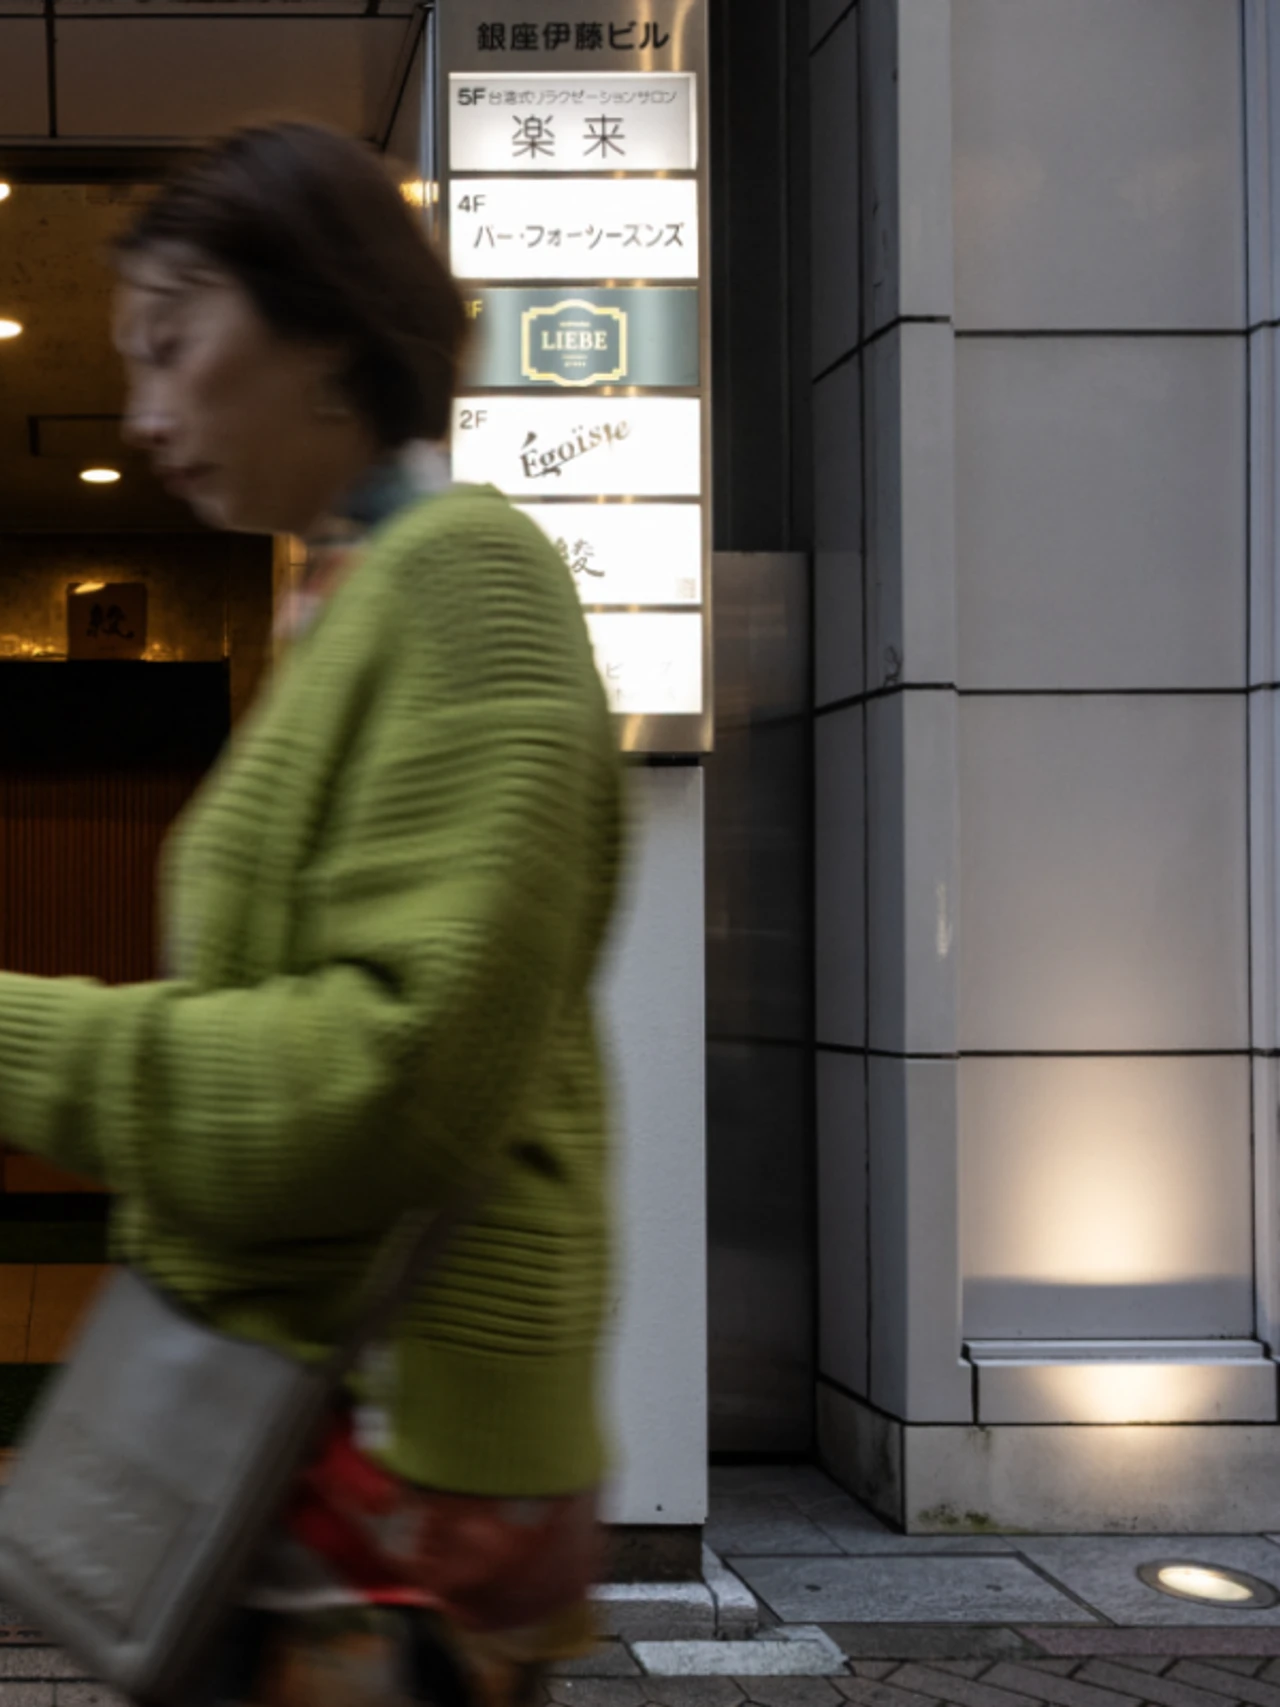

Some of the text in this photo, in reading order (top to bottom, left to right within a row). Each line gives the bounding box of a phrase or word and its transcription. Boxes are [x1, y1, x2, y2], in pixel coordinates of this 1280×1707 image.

[477, 21, 669, 51] 銀座伊藤ビル
[457, 87, 486, 106] 5F
[457, 194, 486, 213] 4F
[541, 330, 608, 351] LIEBE
[460, 410, 488, 430] 2F
